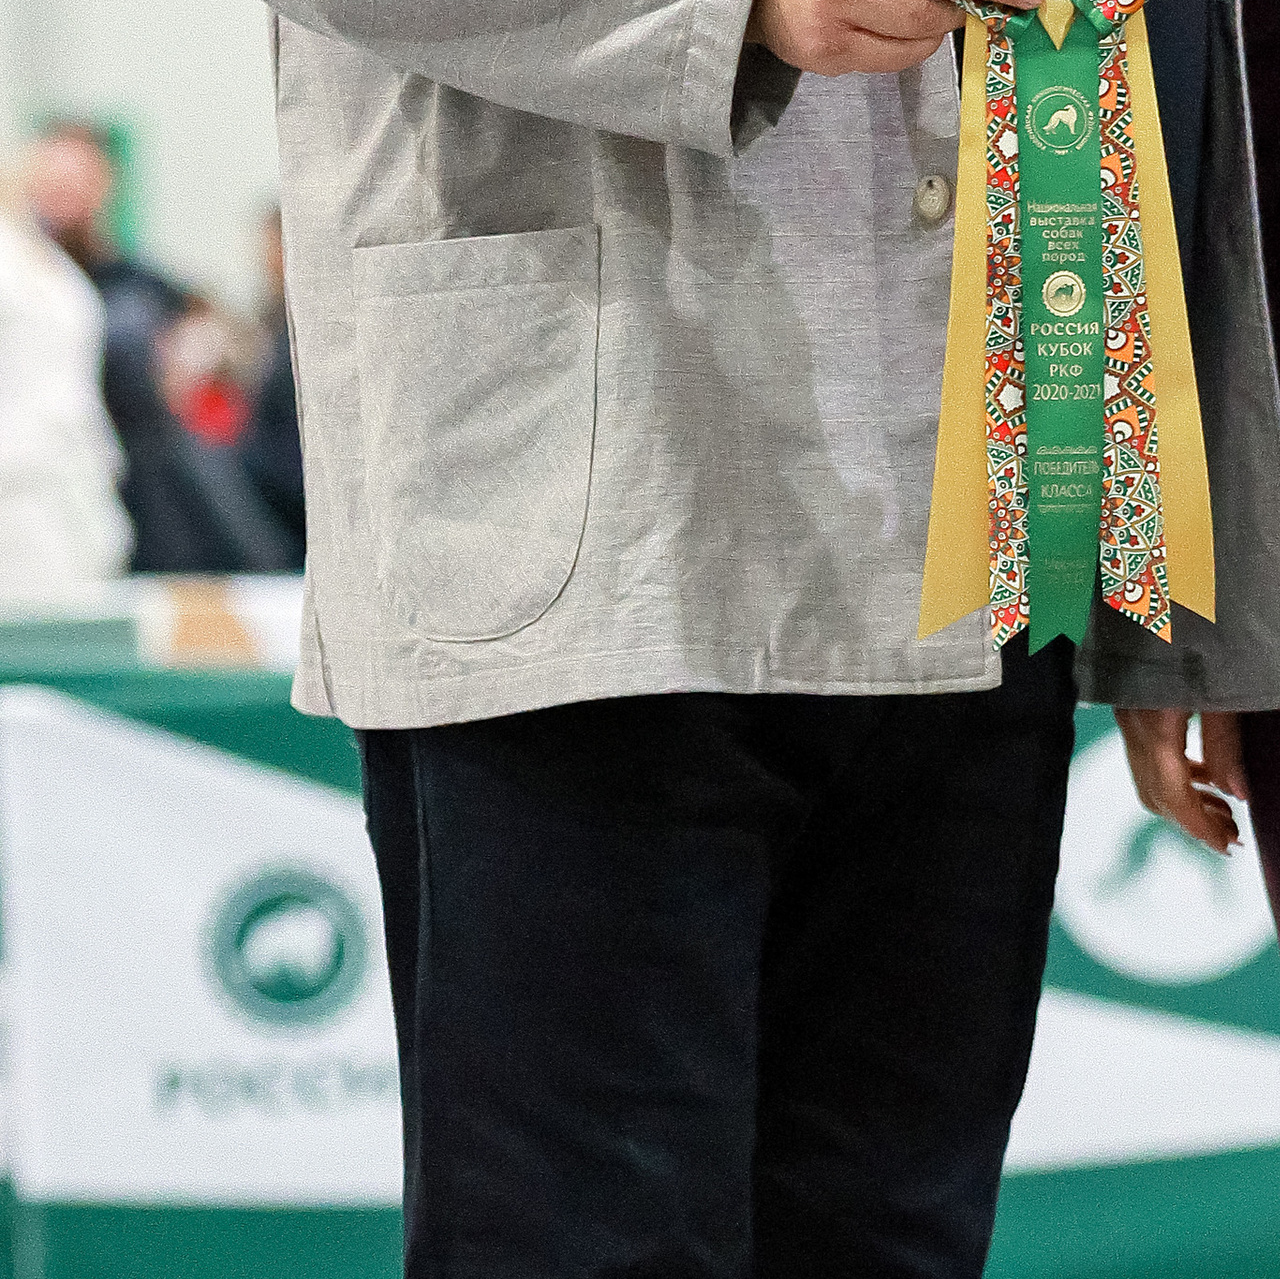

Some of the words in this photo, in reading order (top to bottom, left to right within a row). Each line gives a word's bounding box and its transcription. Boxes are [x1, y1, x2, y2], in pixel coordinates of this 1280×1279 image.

[1030, 216, 1095, 226] выставка
[1042, 225, 1083, 238] собак
[1048, 241, 1079, 250] всех
[1042, 252, 1085, 264] пород
[1030, 322, 1099, 335] РОССИЯ
[1038, 342, 1093, 356] КУБОК
[1049, 364, 1083, 377] РКФ
[1032, 383, 1101, 400] 2020-2021
